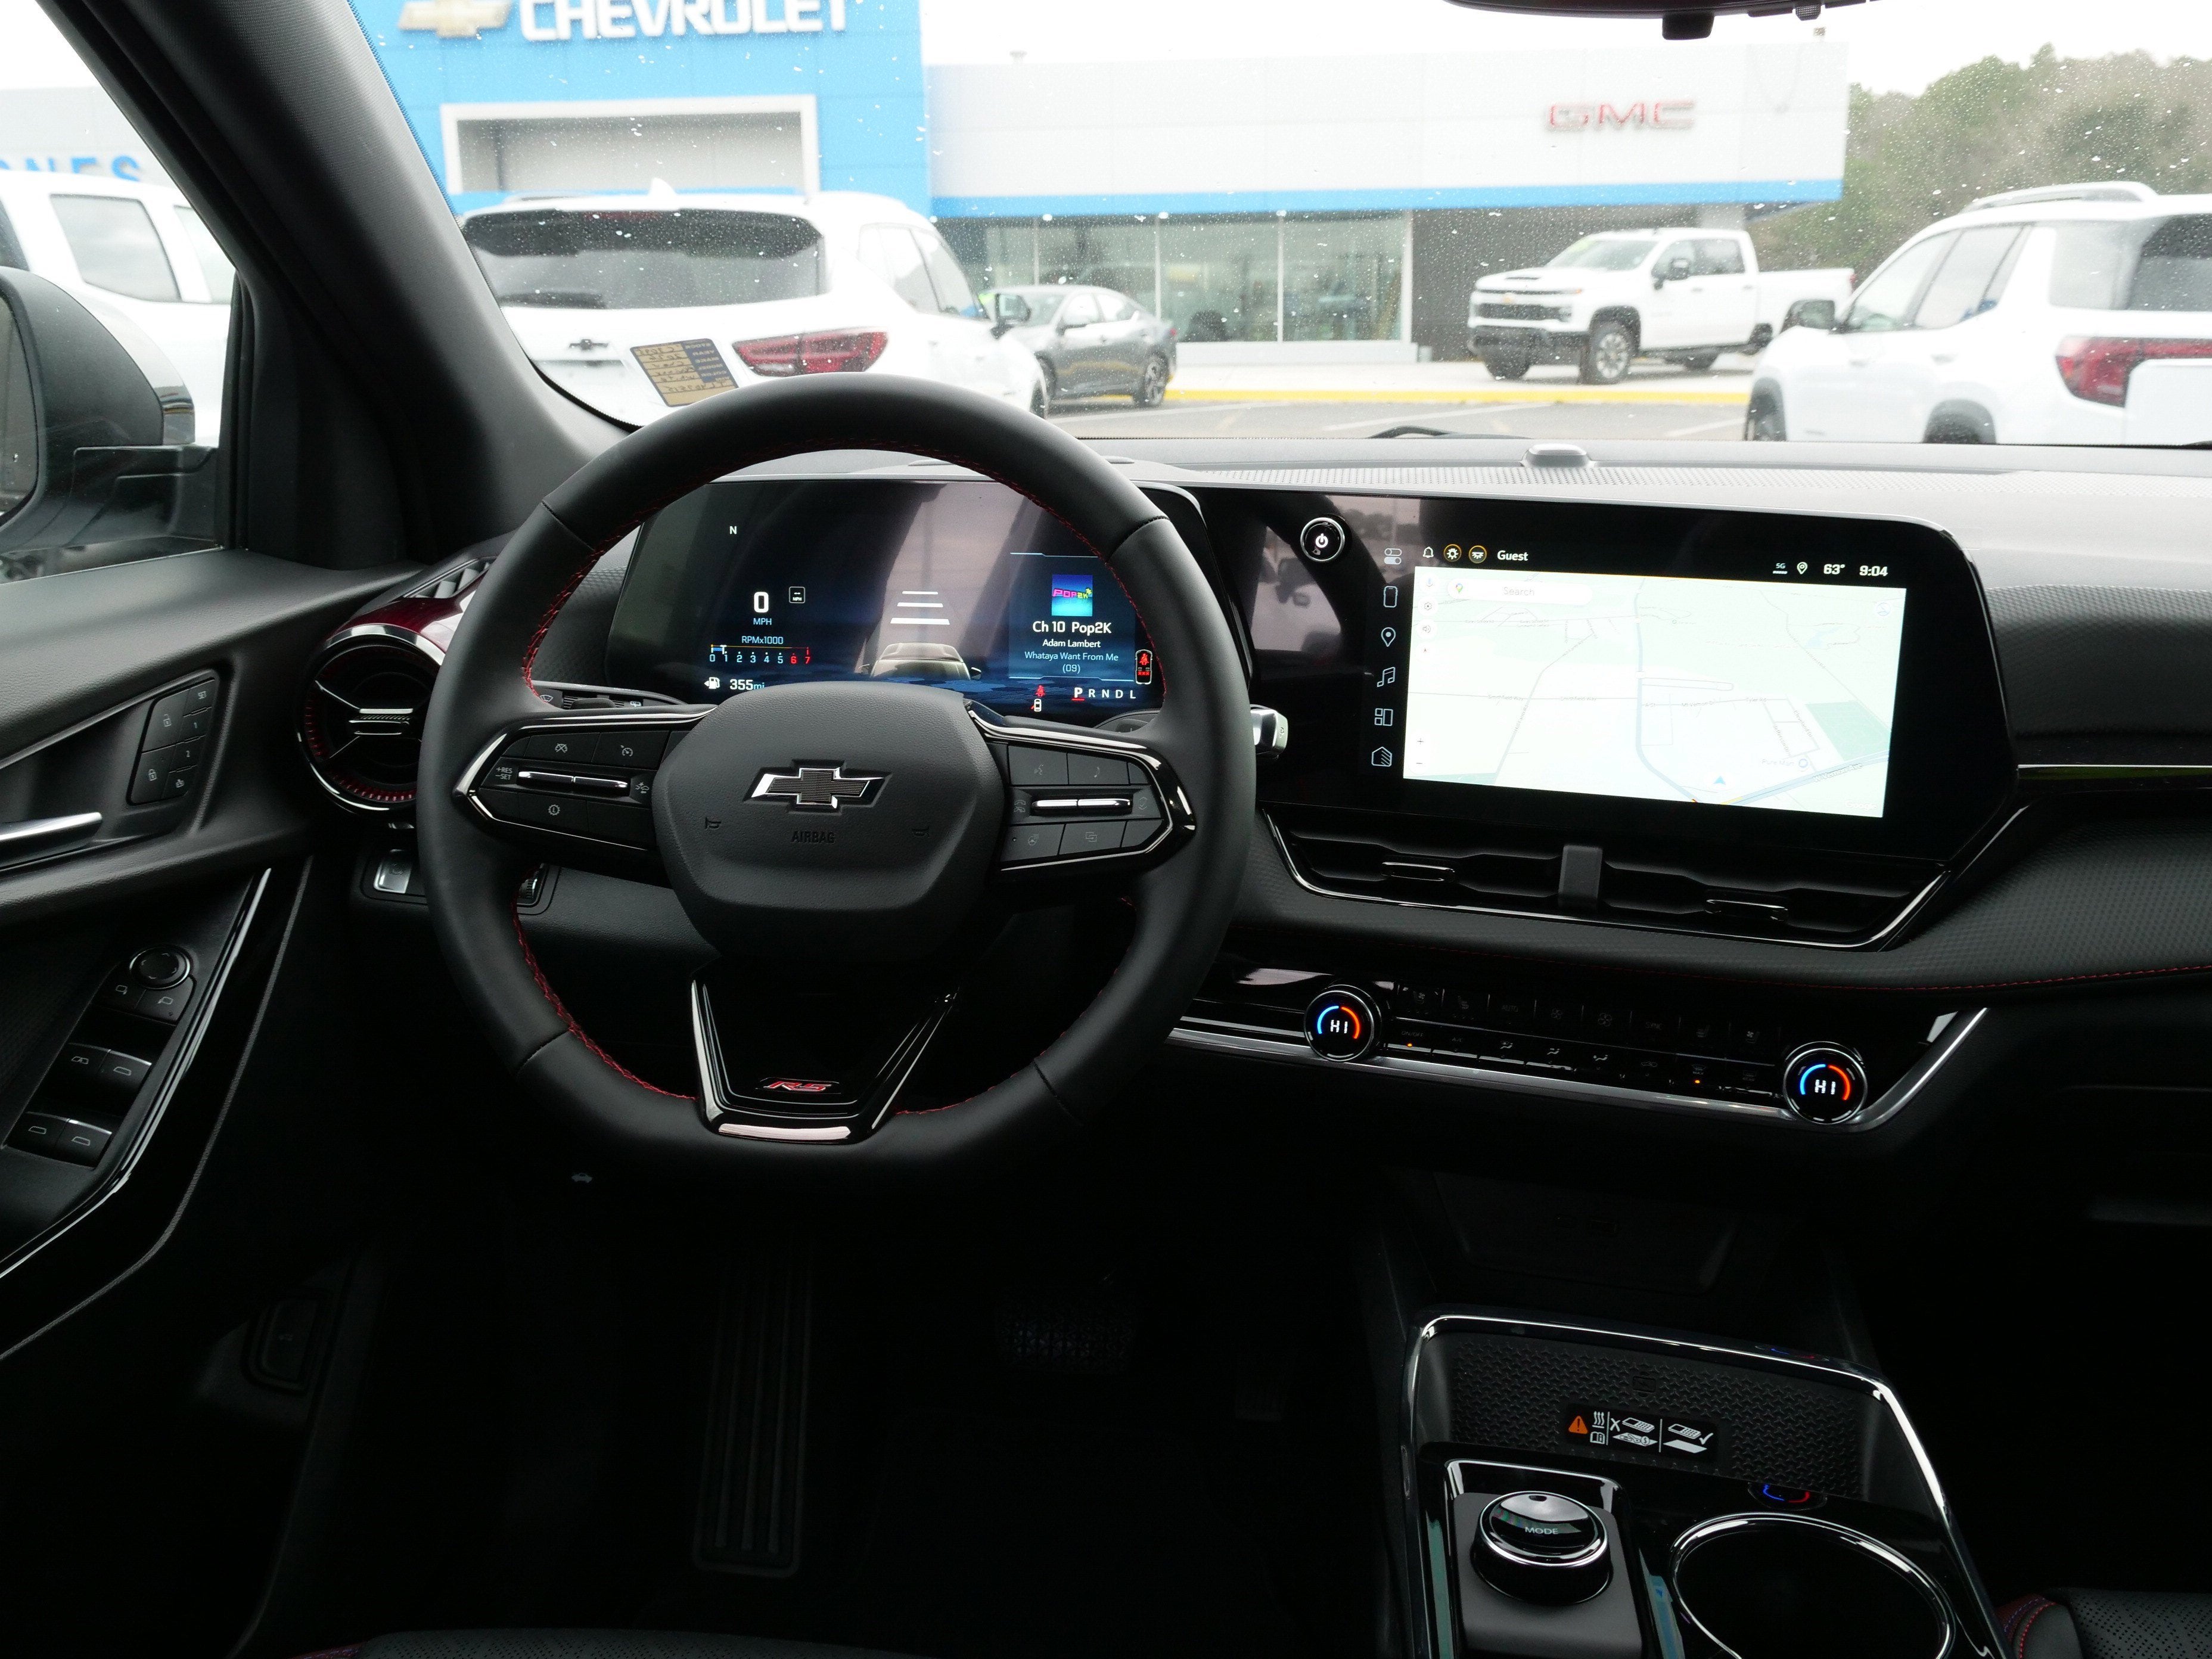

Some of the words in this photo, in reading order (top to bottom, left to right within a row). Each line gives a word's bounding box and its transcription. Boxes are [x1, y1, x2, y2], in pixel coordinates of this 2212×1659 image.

[520, 0, 846, 40] CHEVROLET
[1549, 100, 1695, 128] GMC
[729, 526, 737, 535] N
[1498, 550, 1528, 561] Guest
[1823, 564, 1846, 574] 63°
[1859, 566, 1888, 577] 9:04
[1504, 586, 1534, 596] Search
[754, 591, 769, 613] 0
[1032, 621, 1049, 632] Ch
[1052, 622, 1065, 633] 10
[1072, 622, 1112, 636] Pop2K
[741, 636, 784, 645] RPMx1000
[1042, 639, 1066, 647] Adam
[1068, 639, 1101, 648] Lambert
[790, 656, 797, 664] 6
[1024, 651, 1058, 661] Whataya
[1062, 664, 1080, 674] (09)
[1074, 688, 1083, 698] P
[1089, 689, 1096, 698] R
[1102, 689, 1110, 698] N
[1116, 690, 1123, 698] D
[791, 831, 835, 844] AIRBAG
[1330, 1020, 1348, 1033] HI
[763, 1081, 832, 1092] RS
[1815, 1079, 1836, 1095] HI
